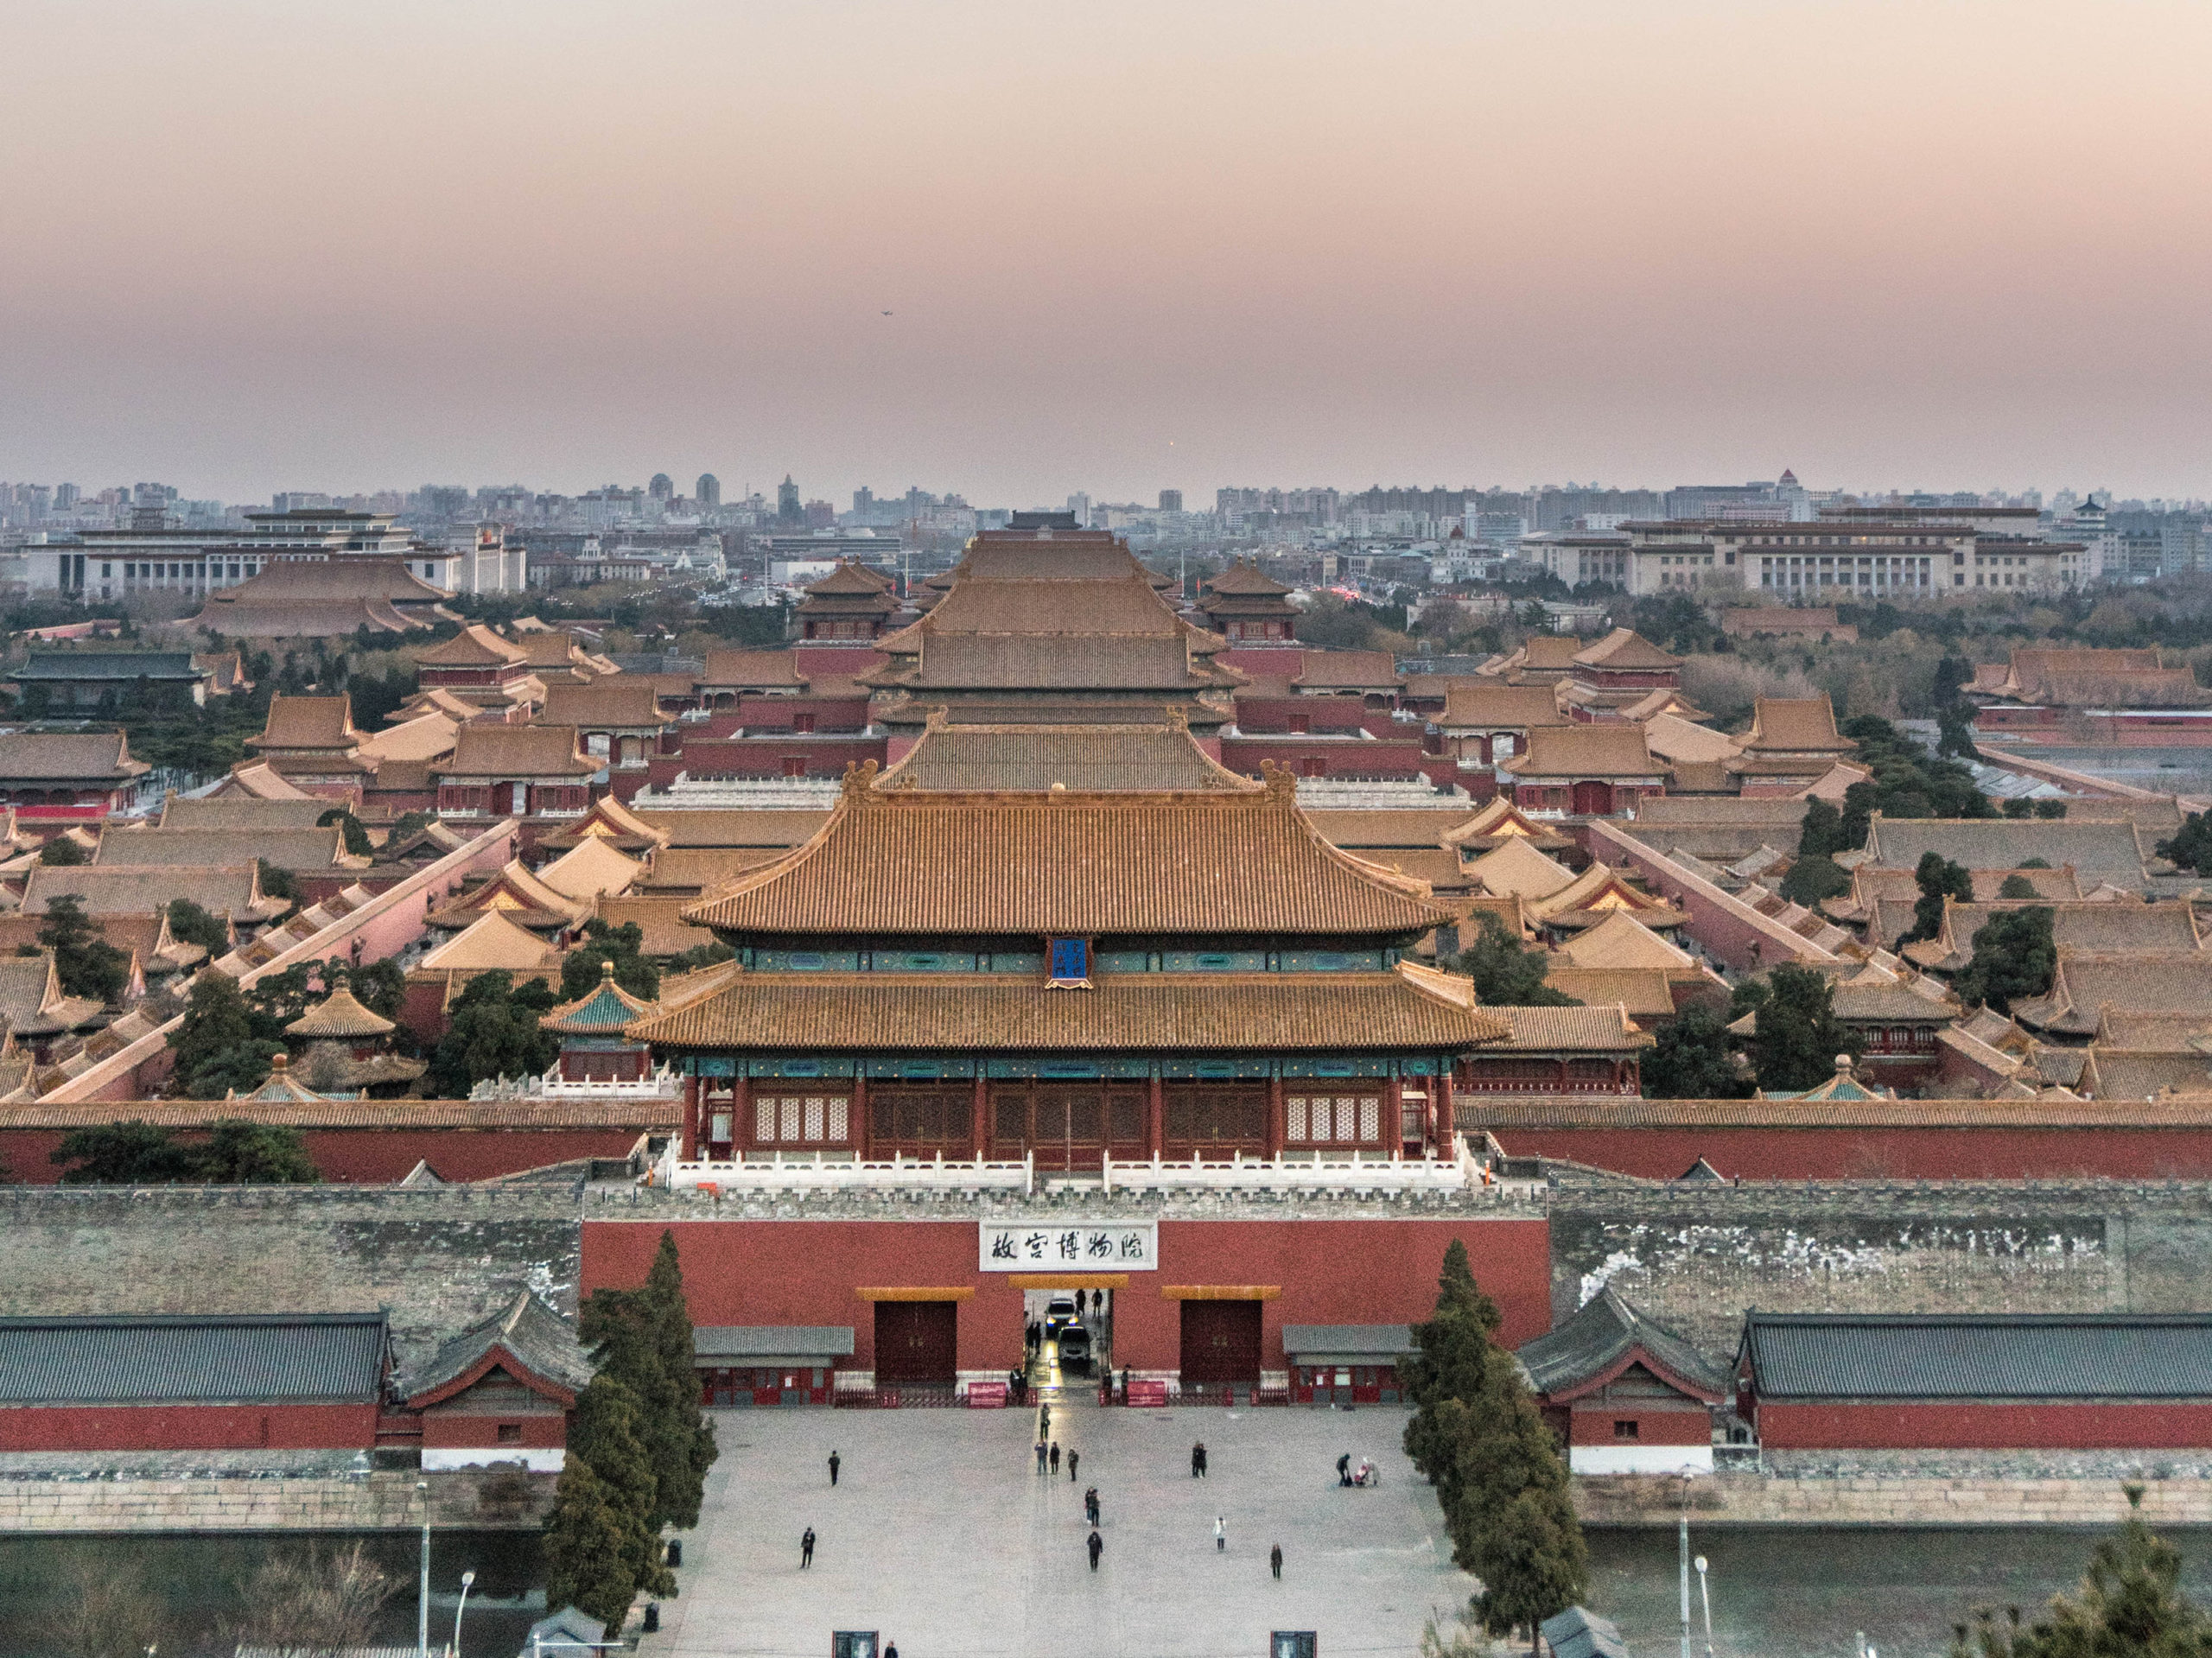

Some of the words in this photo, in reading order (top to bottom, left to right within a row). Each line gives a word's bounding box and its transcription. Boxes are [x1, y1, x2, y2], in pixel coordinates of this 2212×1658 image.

[991, 1231, 1143, 1260] 故宫博物院
